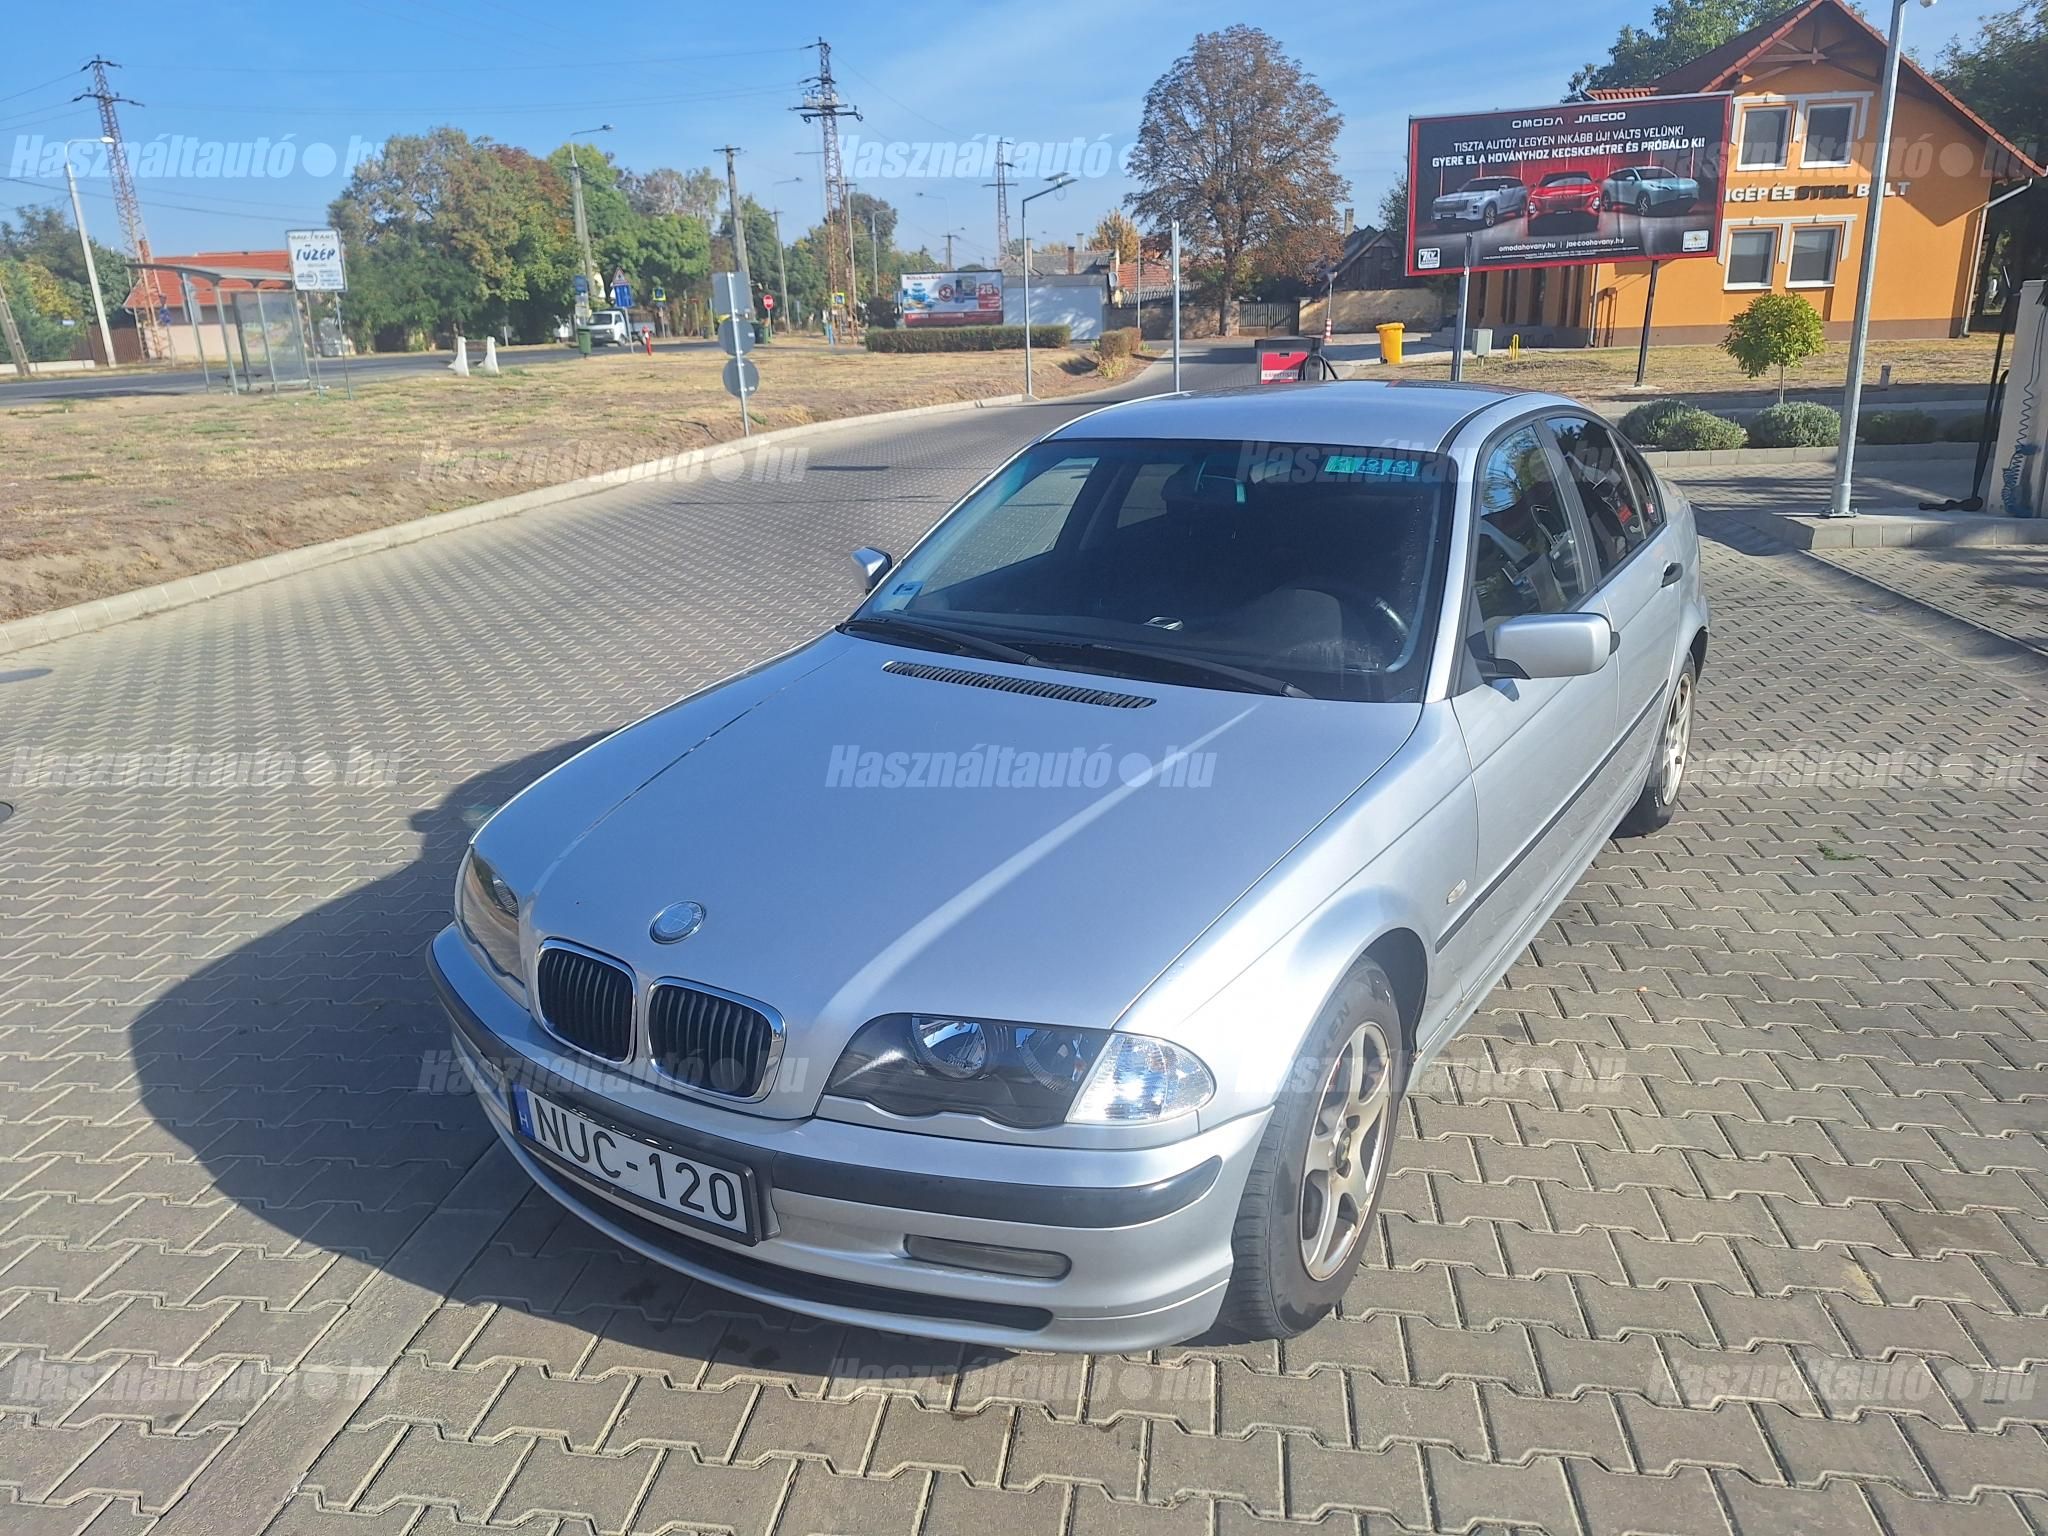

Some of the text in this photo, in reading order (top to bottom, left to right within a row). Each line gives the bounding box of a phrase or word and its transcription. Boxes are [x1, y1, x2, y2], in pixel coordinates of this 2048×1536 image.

[1511, 111, 1626, 129] OMODA JAECOO
[1454, 124, 1684, 153] TISZTA AUTÓ? LEGYEN INKÁBB ÚJ! VÁLTS VELÜNK!
[1432, 137, 1705, 168] GYERE EL A HOVÁNYHOZ KECSKEMÉTRE ÉS PRÓBÁLD KI!
[1771, 183, 1796, 201] ÉS
[1856, 182, 1911, 198] BLT
[518, 1113, 530, 1129] H
[534, 1097, 738, 1222] NUC-120
